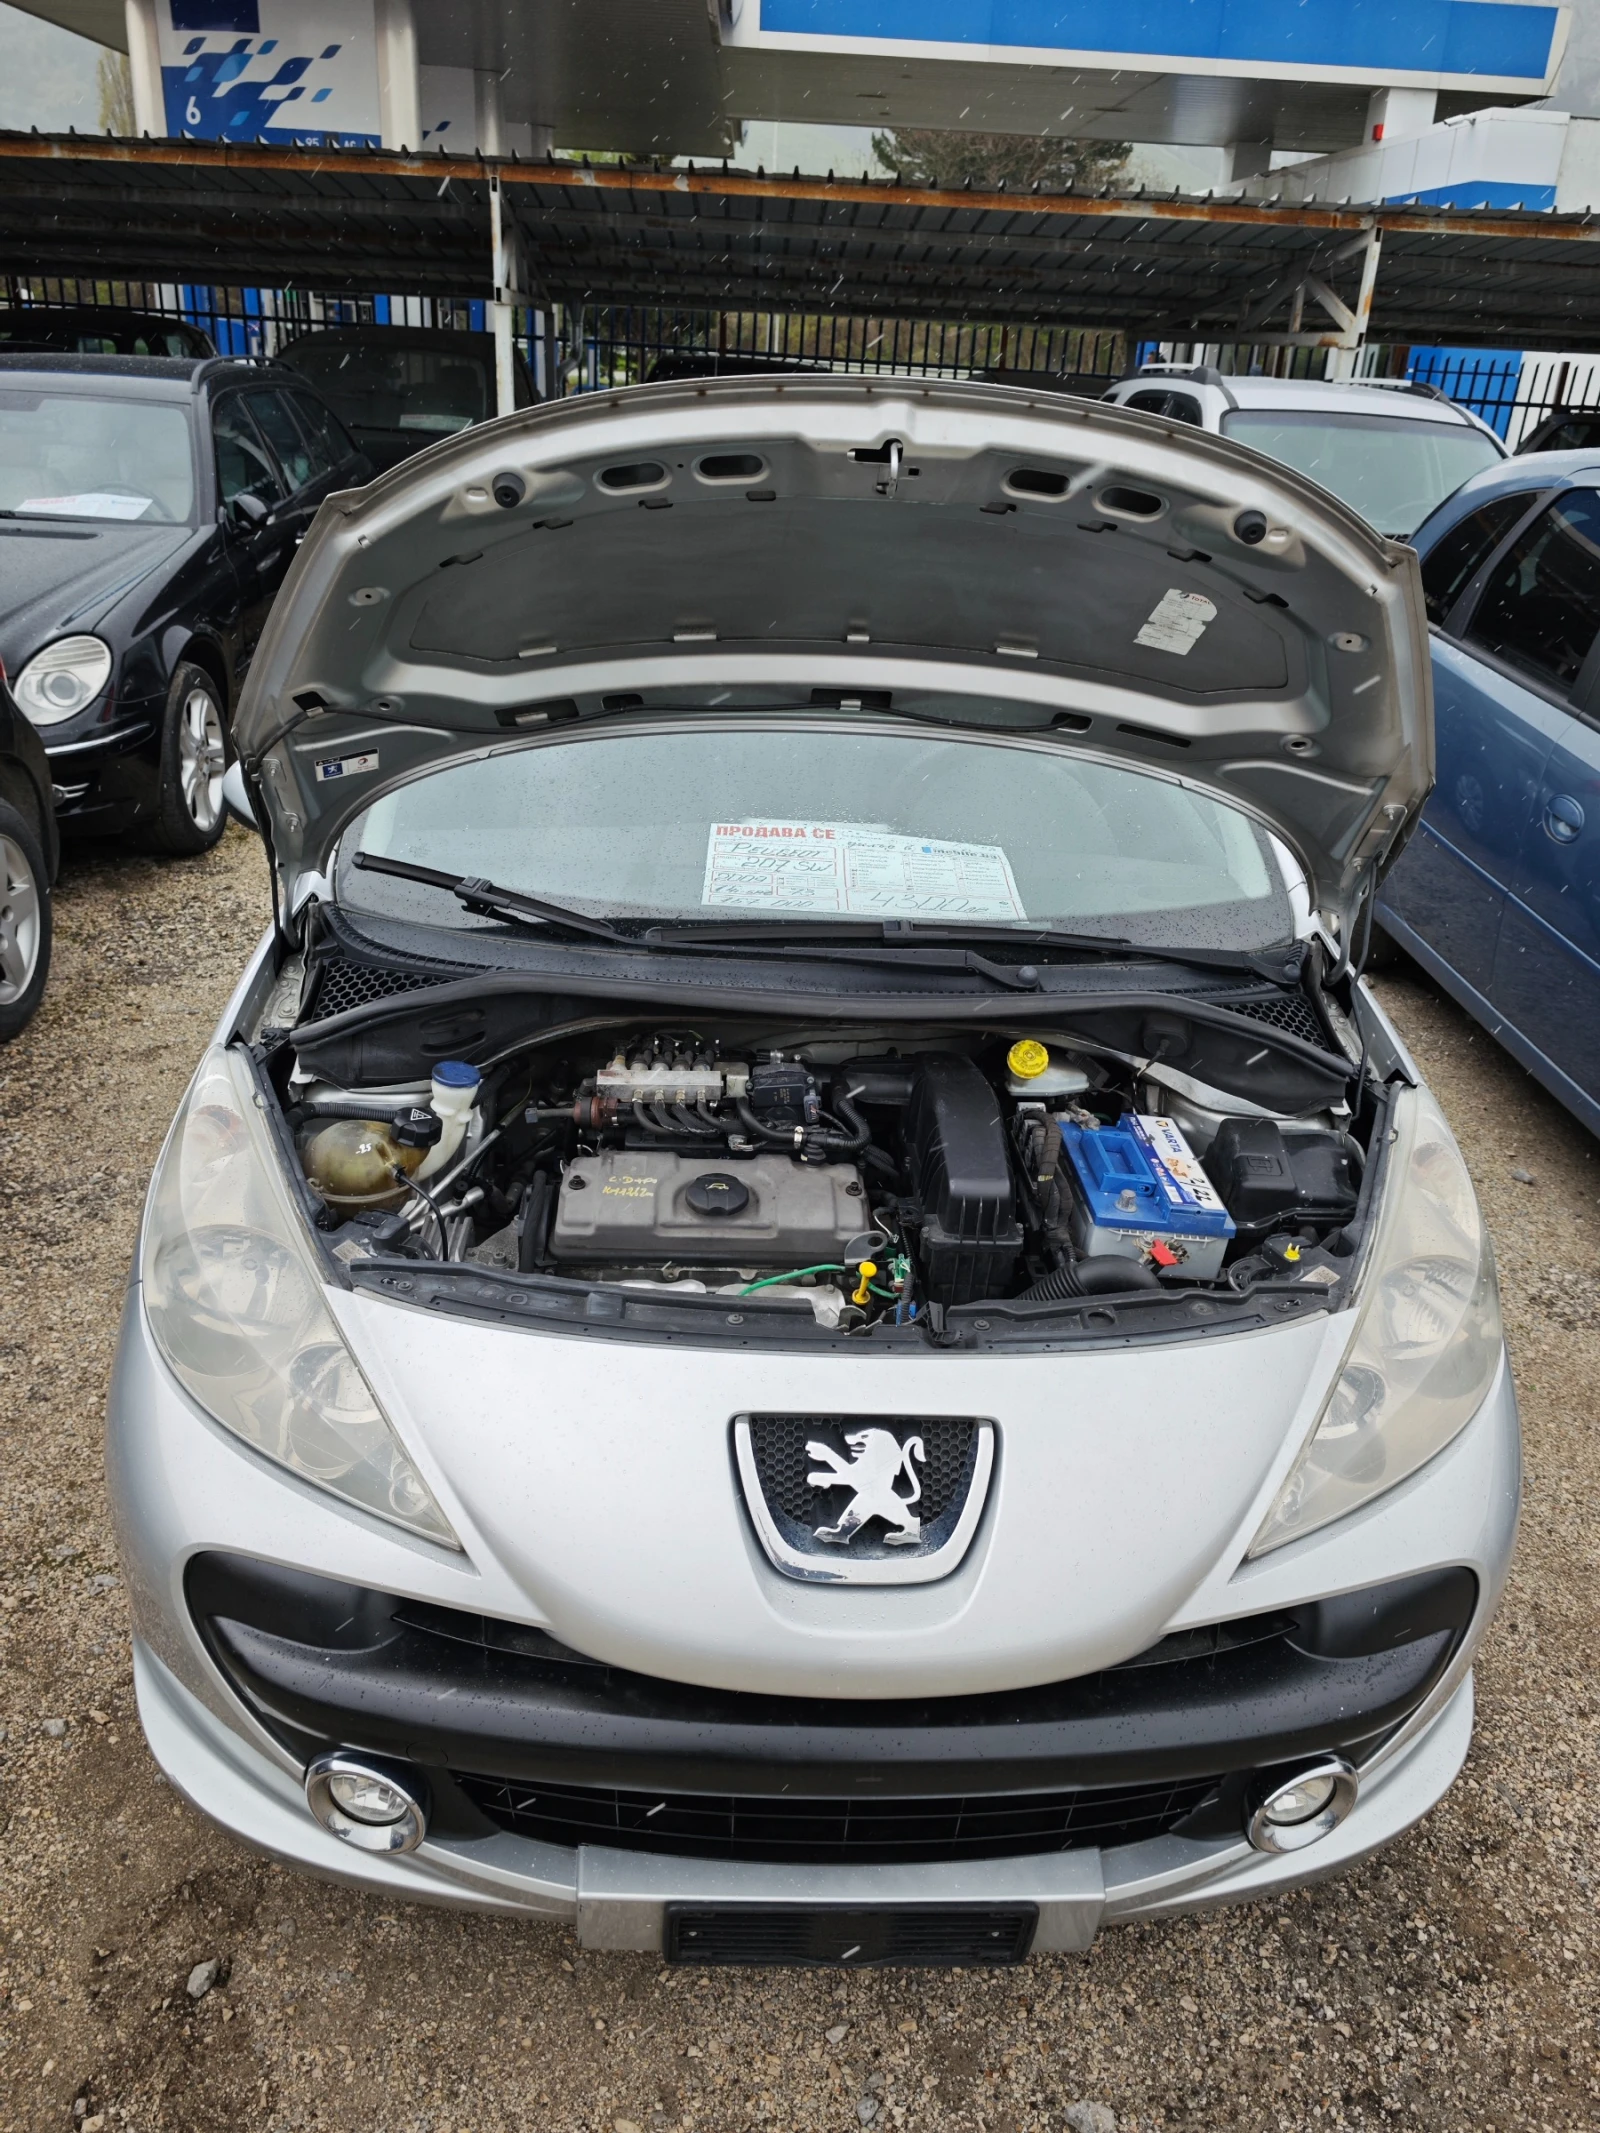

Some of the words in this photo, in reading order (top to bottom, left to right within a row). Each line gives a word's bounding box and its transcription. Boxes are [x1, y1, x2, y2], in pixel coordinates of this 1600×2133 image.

[186, 96, 201, 125] 6
[716, 825, 807, 838] ПРОДАВА
[812, 828, 836, 840] СЕ
[731, 842, 828, 858] PEUGEOT
[740, 856, 791, 873] 207
[793, 860, 833, 872] SW
[1161, 1128, 1182, 1153] VARTA
